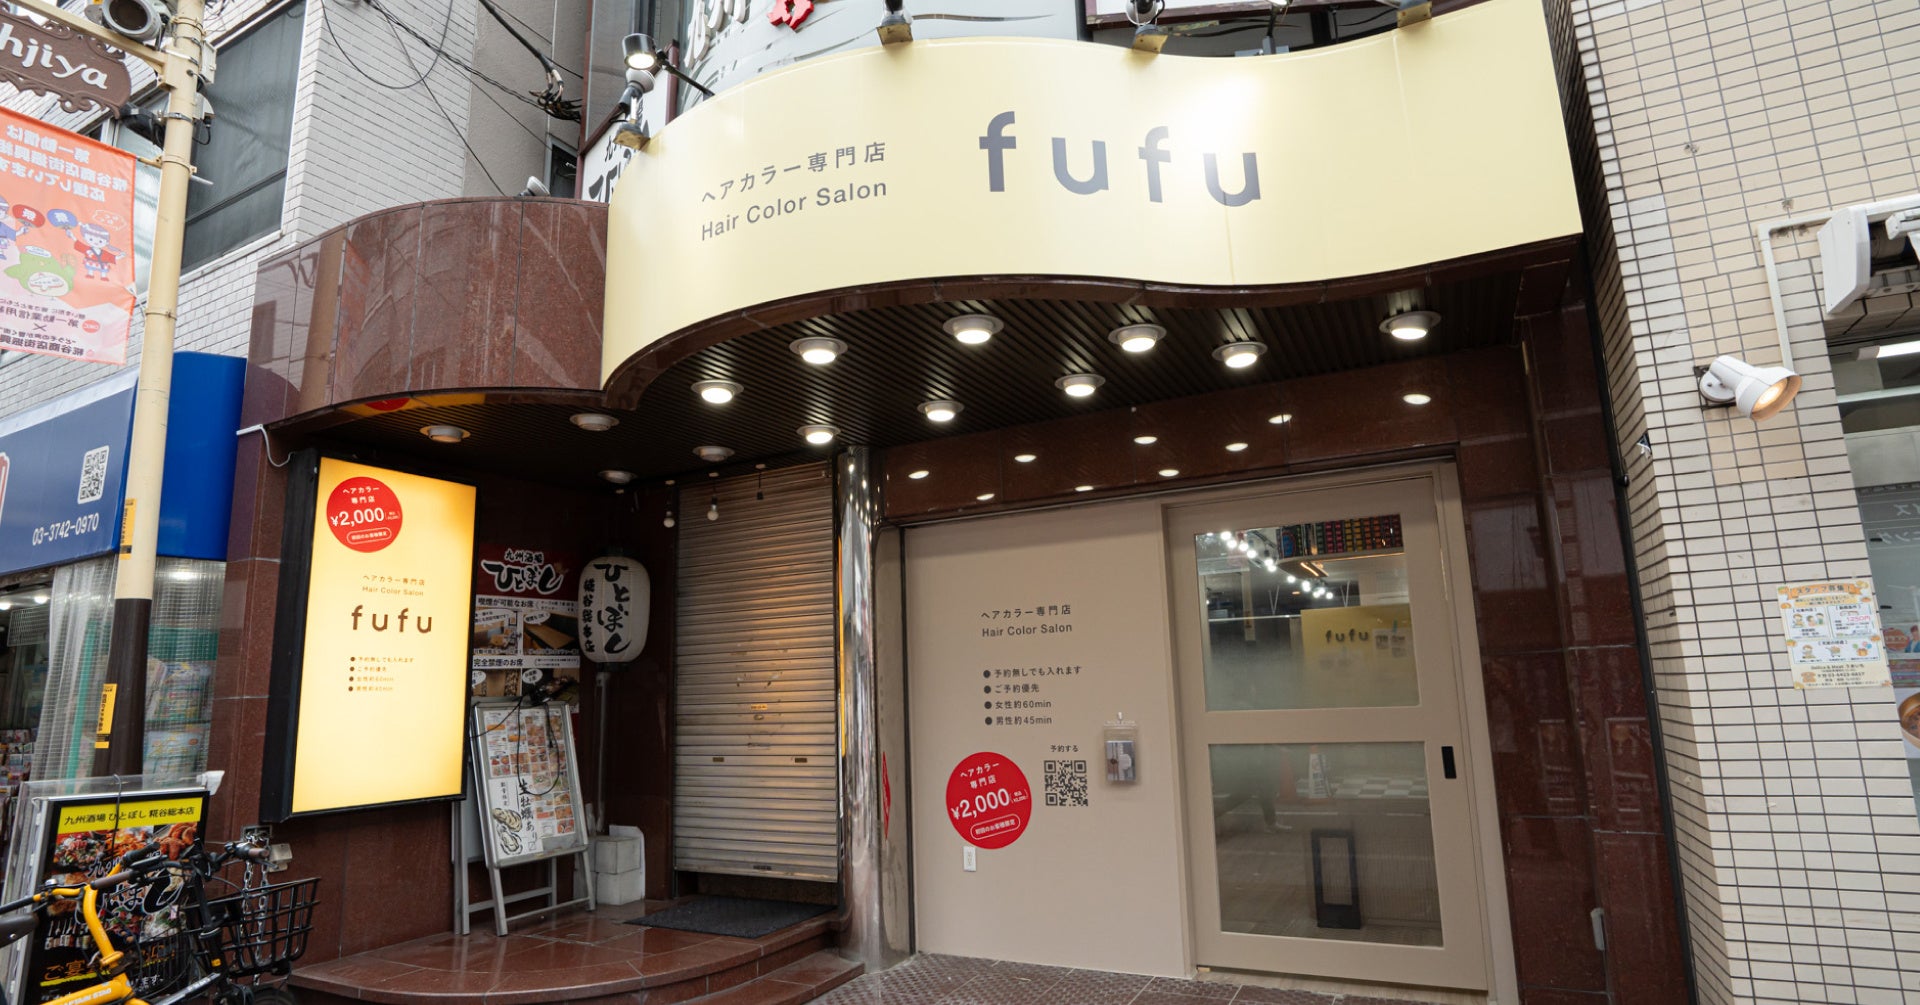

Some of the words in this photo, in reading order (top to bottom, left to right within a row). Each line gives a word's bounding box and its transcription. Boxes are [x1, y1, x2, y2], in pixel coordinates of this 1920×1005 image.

[978, 110, 1262, 208] fufu
[701, 141, 886, 203] ヘアカラー専門店
[701, 214, 739, 241] Hair
[746, 196, 807, 224] Color
[815, 182, 887, 206] Salon
[342, 485, 380, 495] ヘアカラー
[330, 507, 385, 527] ¥2,000
[32, 512, 100, 546] 03-3742-0970
[362, 574, 426, 587] ヘアカラー専門店
[481, 560, 564, 595] ひとぼし
[362, 586, 379, 594] Hair
[380, 587, 401, 595] Color
[403, 589, 425, 597] Salon
[593, 562, 632, 655] ひとぼし
[980, 604, 1071, 620] ヘアカラー専門店
[352, 604, 432, 633] fufu
[982, 627, 1004, 637] Hair
[1007, 625, 1037, 636] Color
[1040, 623, 1073, 634] Salon
[1325, 628, 1369, 644] fufu
[994, 665, 1082, 679] 予約無しでも入れます
[994, 683, 1040, 694] ご予約優先
[1050, 744, 1079, 753] 予約する
[960, 762, 1000, 777] ヘアカラー
[970, 774, 997, 789] 専門店
[951, 788, 1011, 820] ¥2,000
[64, 812, 107, 826] 九州酒場
[108, 811, 147, 822] ひとぼし
[149, 806, 196, 818] 糀谷総本店
